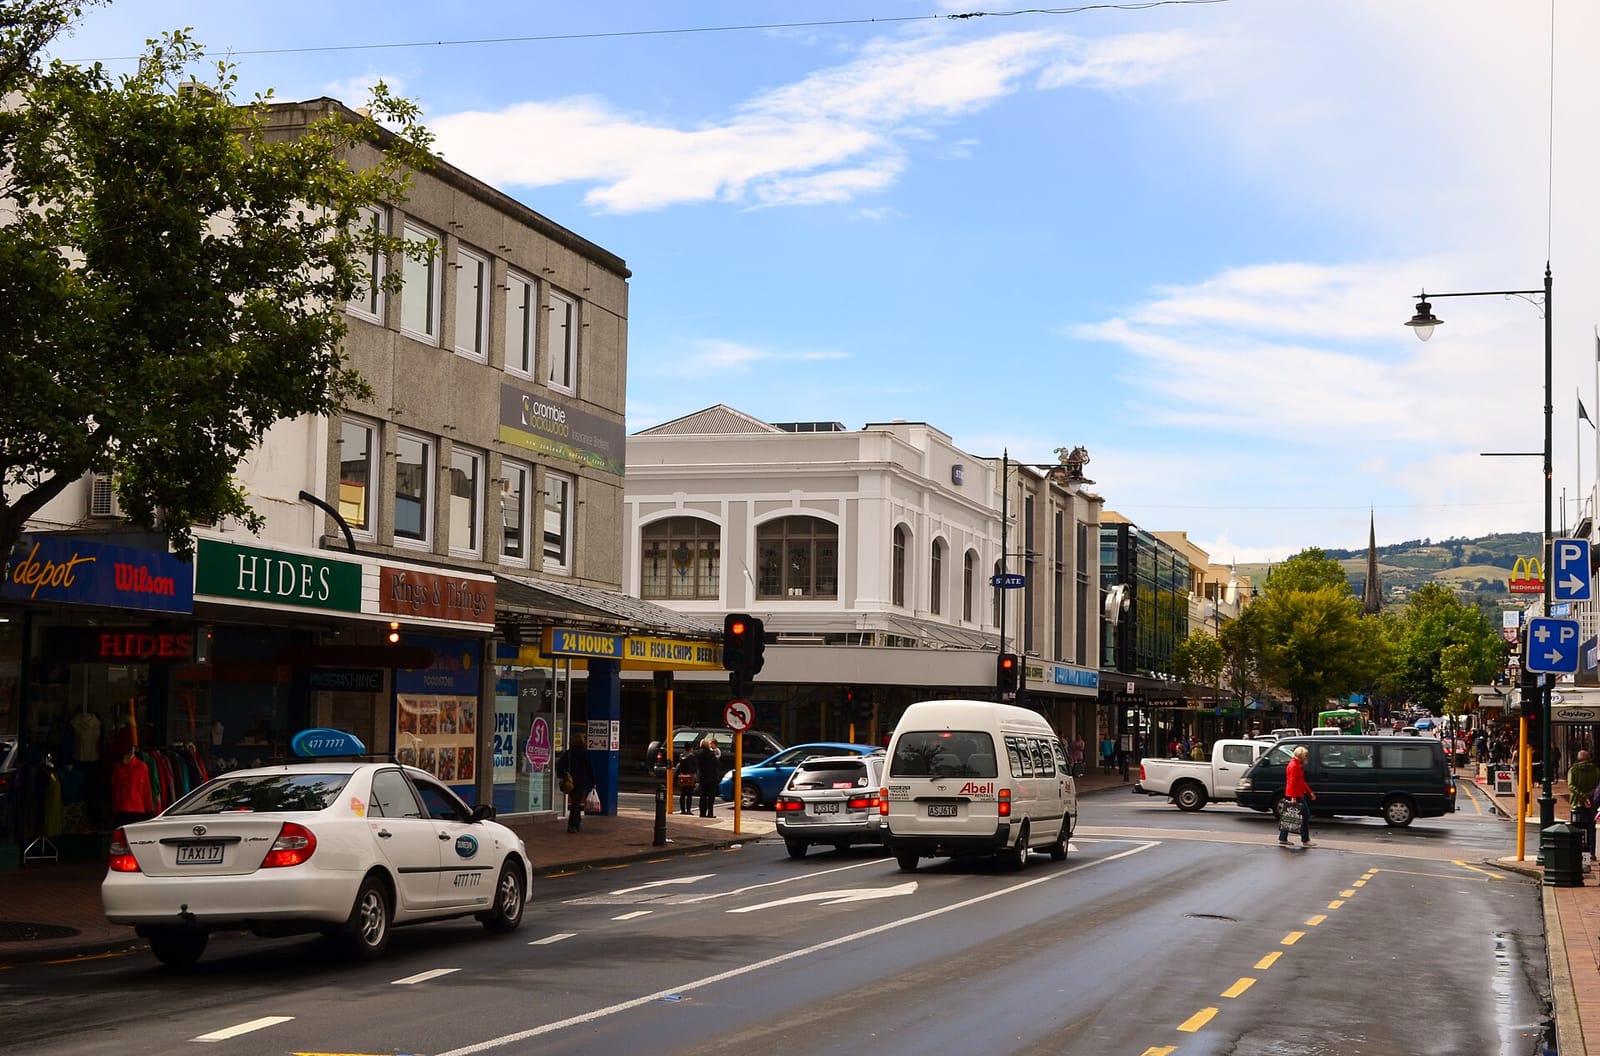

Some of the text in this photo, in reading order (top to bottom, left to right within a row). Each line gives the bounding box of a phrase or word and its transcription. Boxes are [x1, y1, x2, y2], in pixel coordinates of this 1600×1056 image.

[533, 402, 566, 423] crombie
[532, 414, 569, 438] lockwood
[1560, 544, 1582, 570] P
[13, 542, 96, 598] depot
[114, 562, 175, 596] Wilson
[236, 554, 330, 601] HIDES
[391, 571, 488, 616] Rings & Things
[99, 634, 191, 657] HIDES
[562, 633, 615, 654] 24 HOURS
[1560, 627, 1575, 644] P
[631, 641, 646, 657] DELI
[651, 642, 666, 658] FISH
[666, 644, 673, 658] &
[673, 645, 693, 661] CHIPS
[697, 647, 713, 663] BEER
[588, 726, 608, 736] Bread
[309, 739, 345, 748] 477 7777
[495, 735, 514, 754] 24
[960, 782, 994, 794] Abell
[181, 846, 220, 860] TAXI 17
[453, 873, 481, 887] 4777 777
